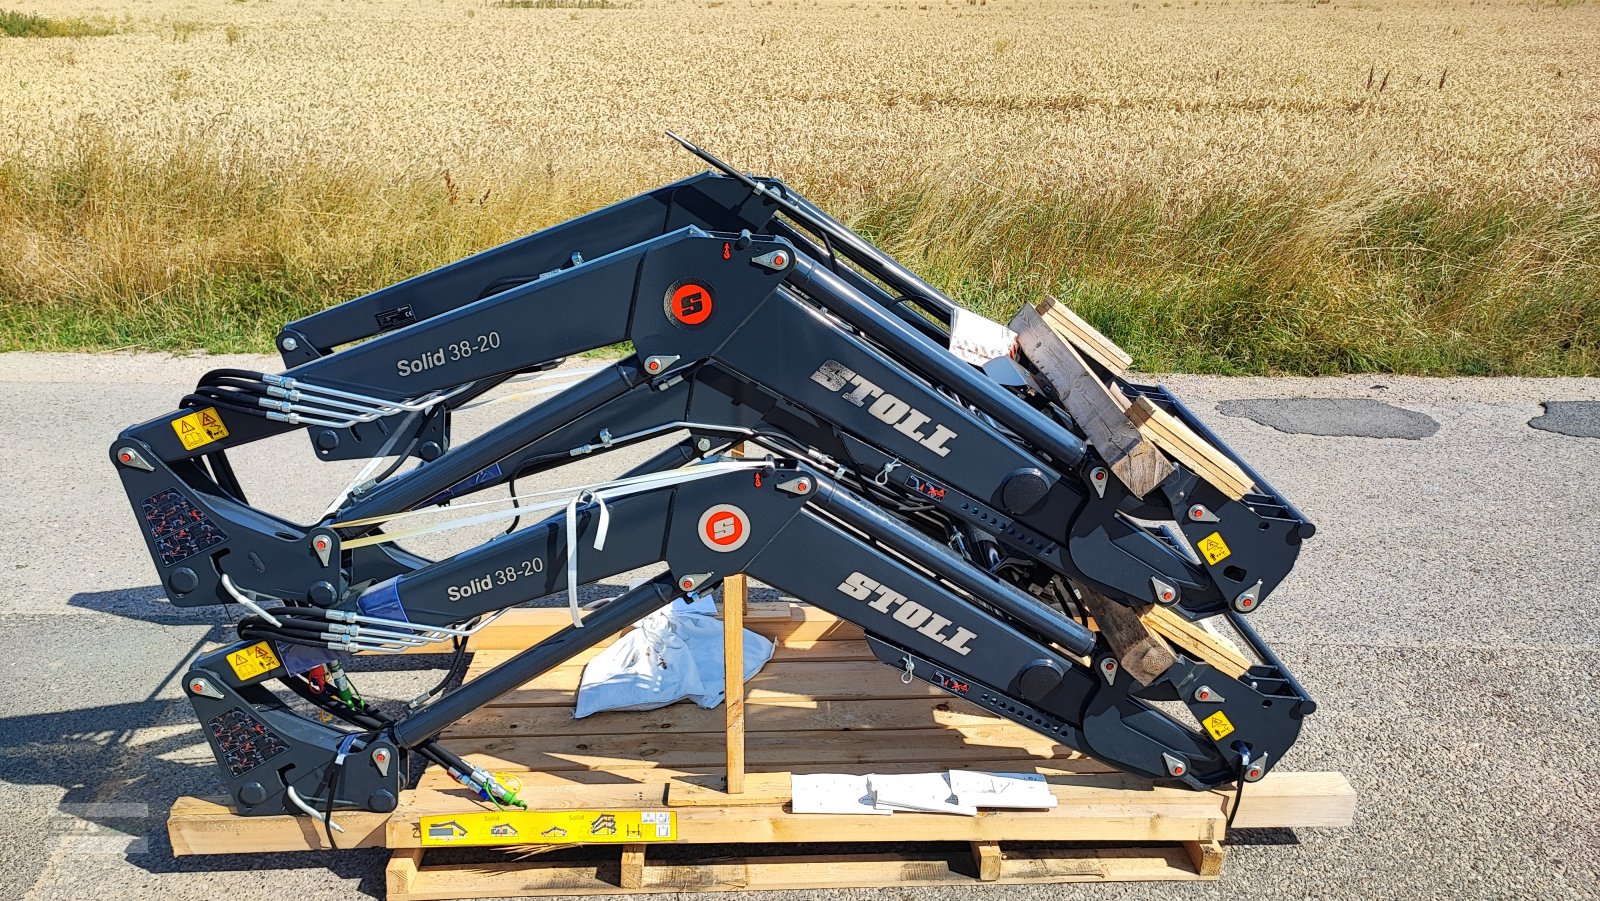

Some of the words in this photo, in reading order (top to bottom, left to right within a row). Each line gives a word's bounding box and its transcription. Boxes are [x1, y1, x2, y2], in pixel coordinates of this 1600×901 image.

[397, 348, 446, 377] Solid
[449, 331, 500, 361] 38-20
[809, 359, 958, 458] STOLL
[713, 516, 735, 541] S
[447, 574, 493, 602] Solid
[495, 557, 543, 585] 38-20
[836, 571, 978, 656] STOLL
[484, 814, 500, 822] Solid
